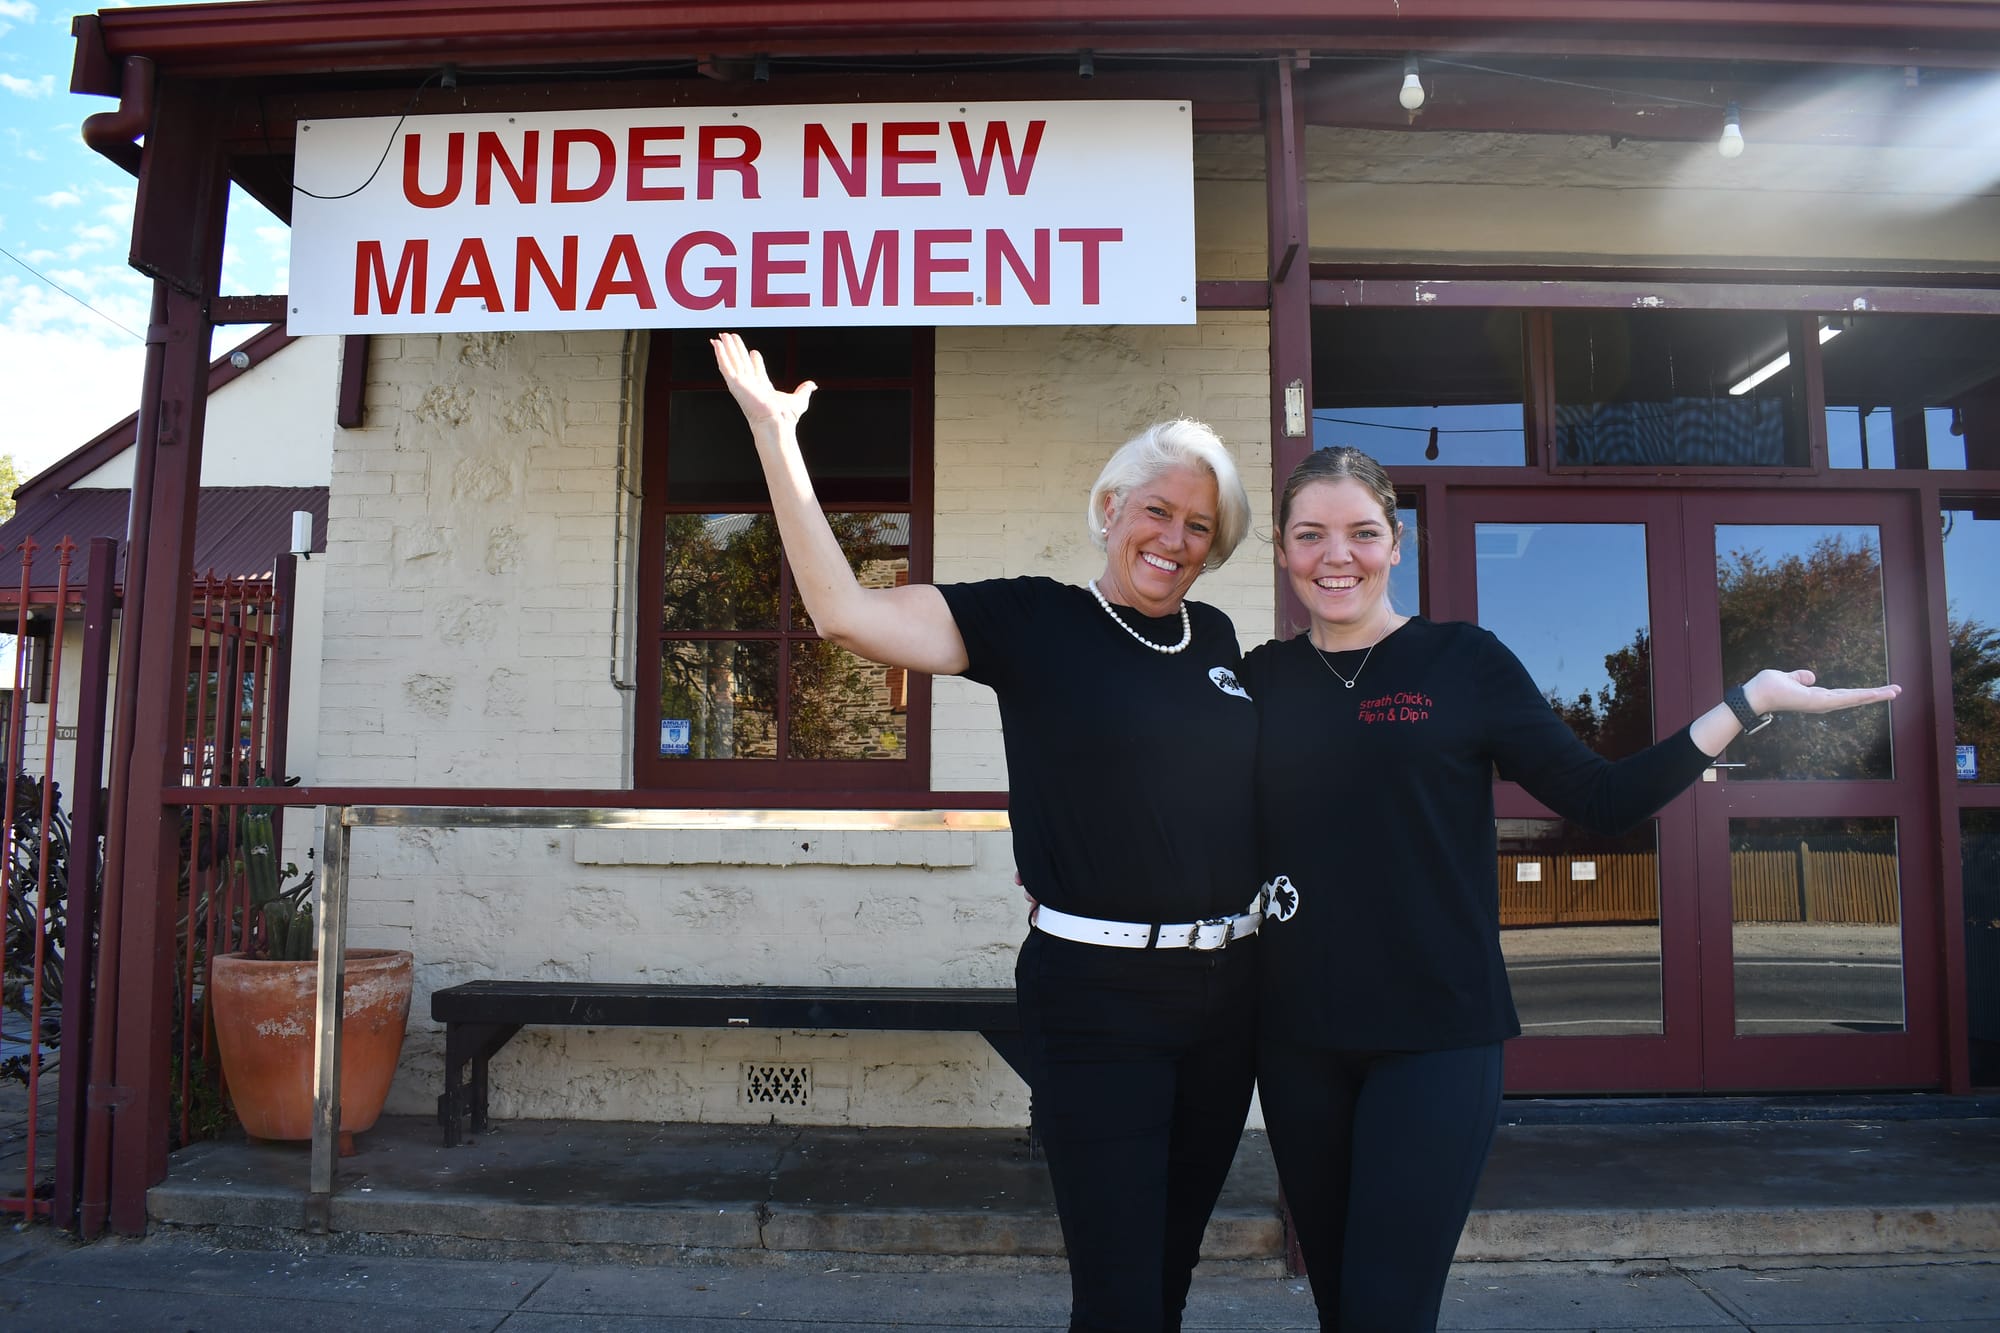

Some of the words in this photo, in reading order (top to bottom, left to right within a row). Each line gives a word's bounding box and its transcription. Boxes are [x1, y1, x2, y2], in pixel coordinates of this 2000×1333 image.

[403, 126, 763, 209] UNDER
[803, 120, 1046, 198] NEW
[354, 228, 1124, 315] MANAGEMENT
[1359, 694, 1392, 709] Strath
[1387, 707, 1396, 721] &
